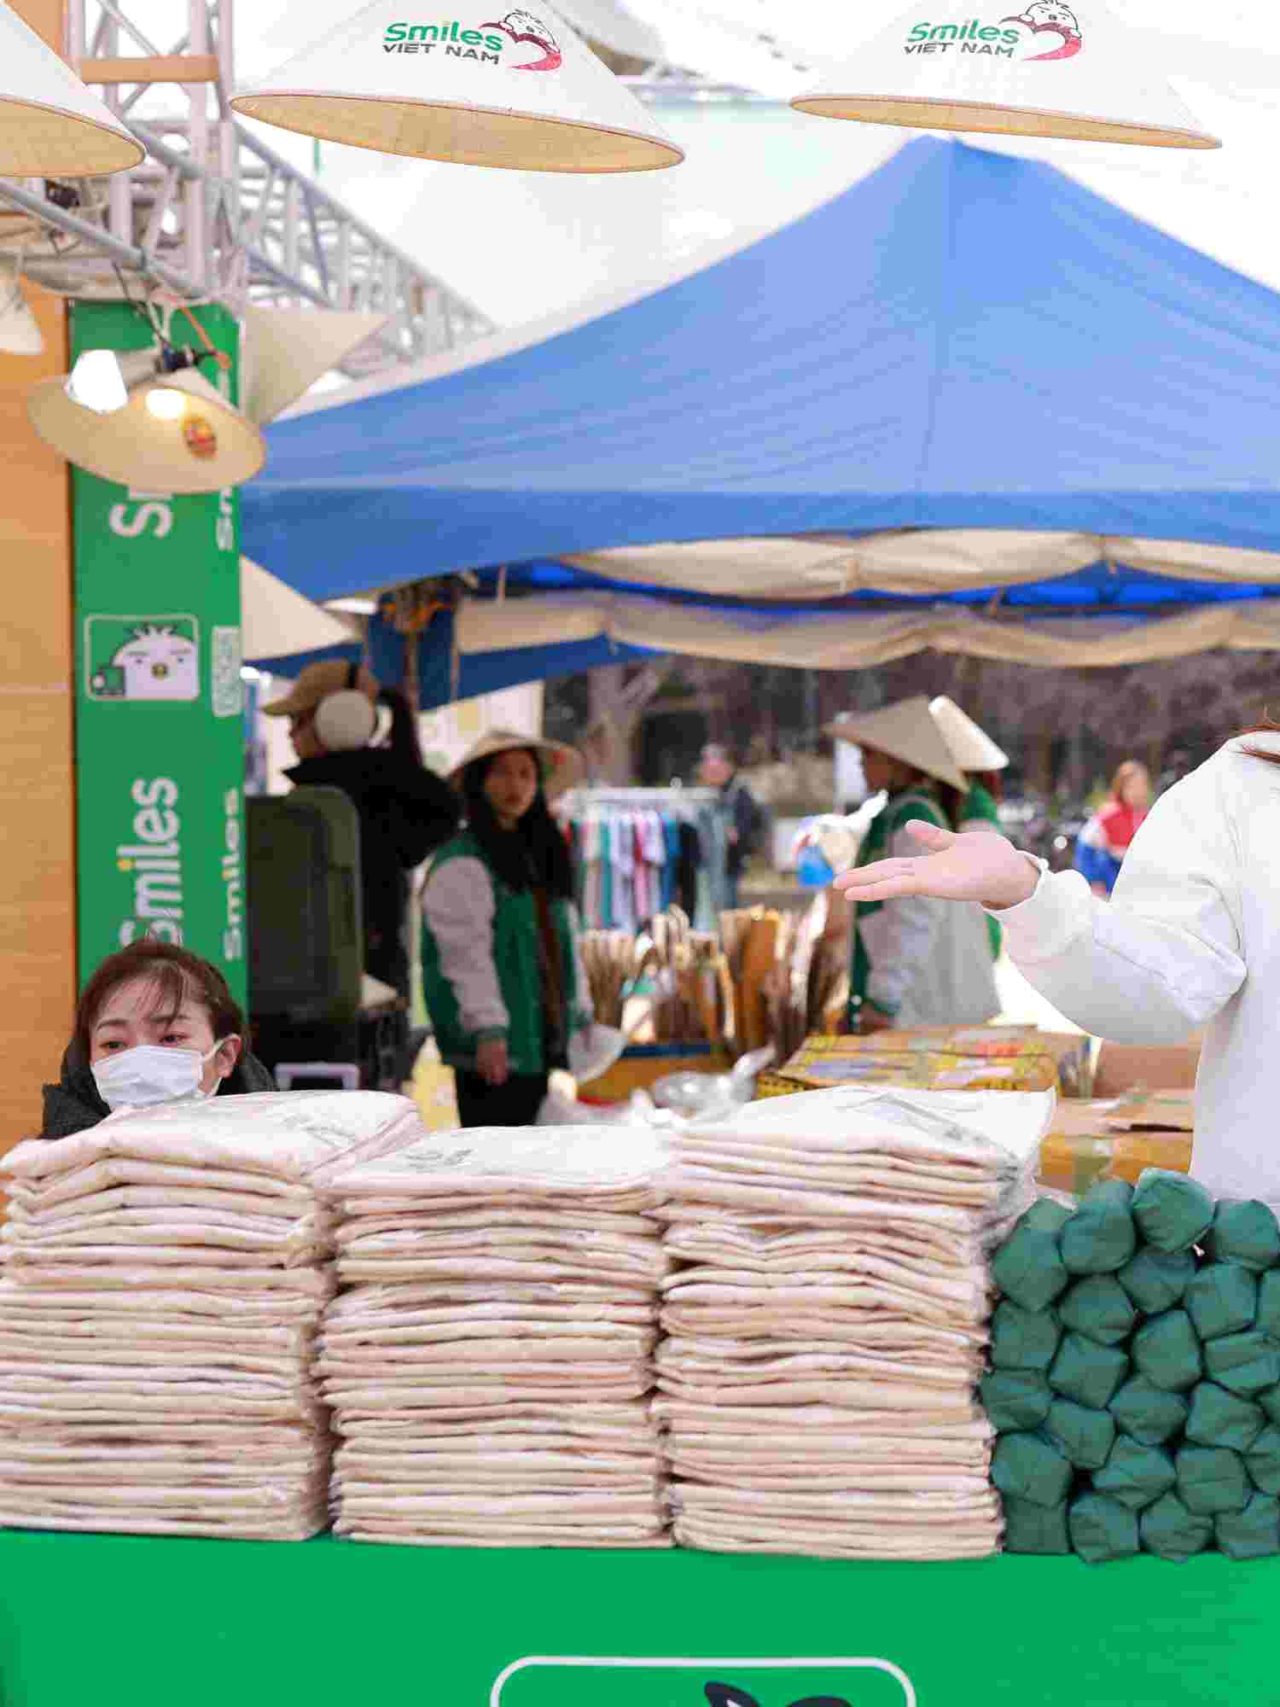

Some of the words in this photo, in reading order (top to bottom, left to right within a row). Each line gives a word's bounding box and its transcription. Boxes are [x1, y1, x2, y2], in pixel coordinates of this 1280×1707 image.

[384, 21, 503, 51] Smiles
[907, 19, 1019, 44] Smiles
[383, 43, 435, 54] VIET
[445, 46, 499, 65] NAM
[904, 42, 953, 54] VIET
[961, 43, 1014, 58] NAM
[221, 787, 241, 960] Smiles
